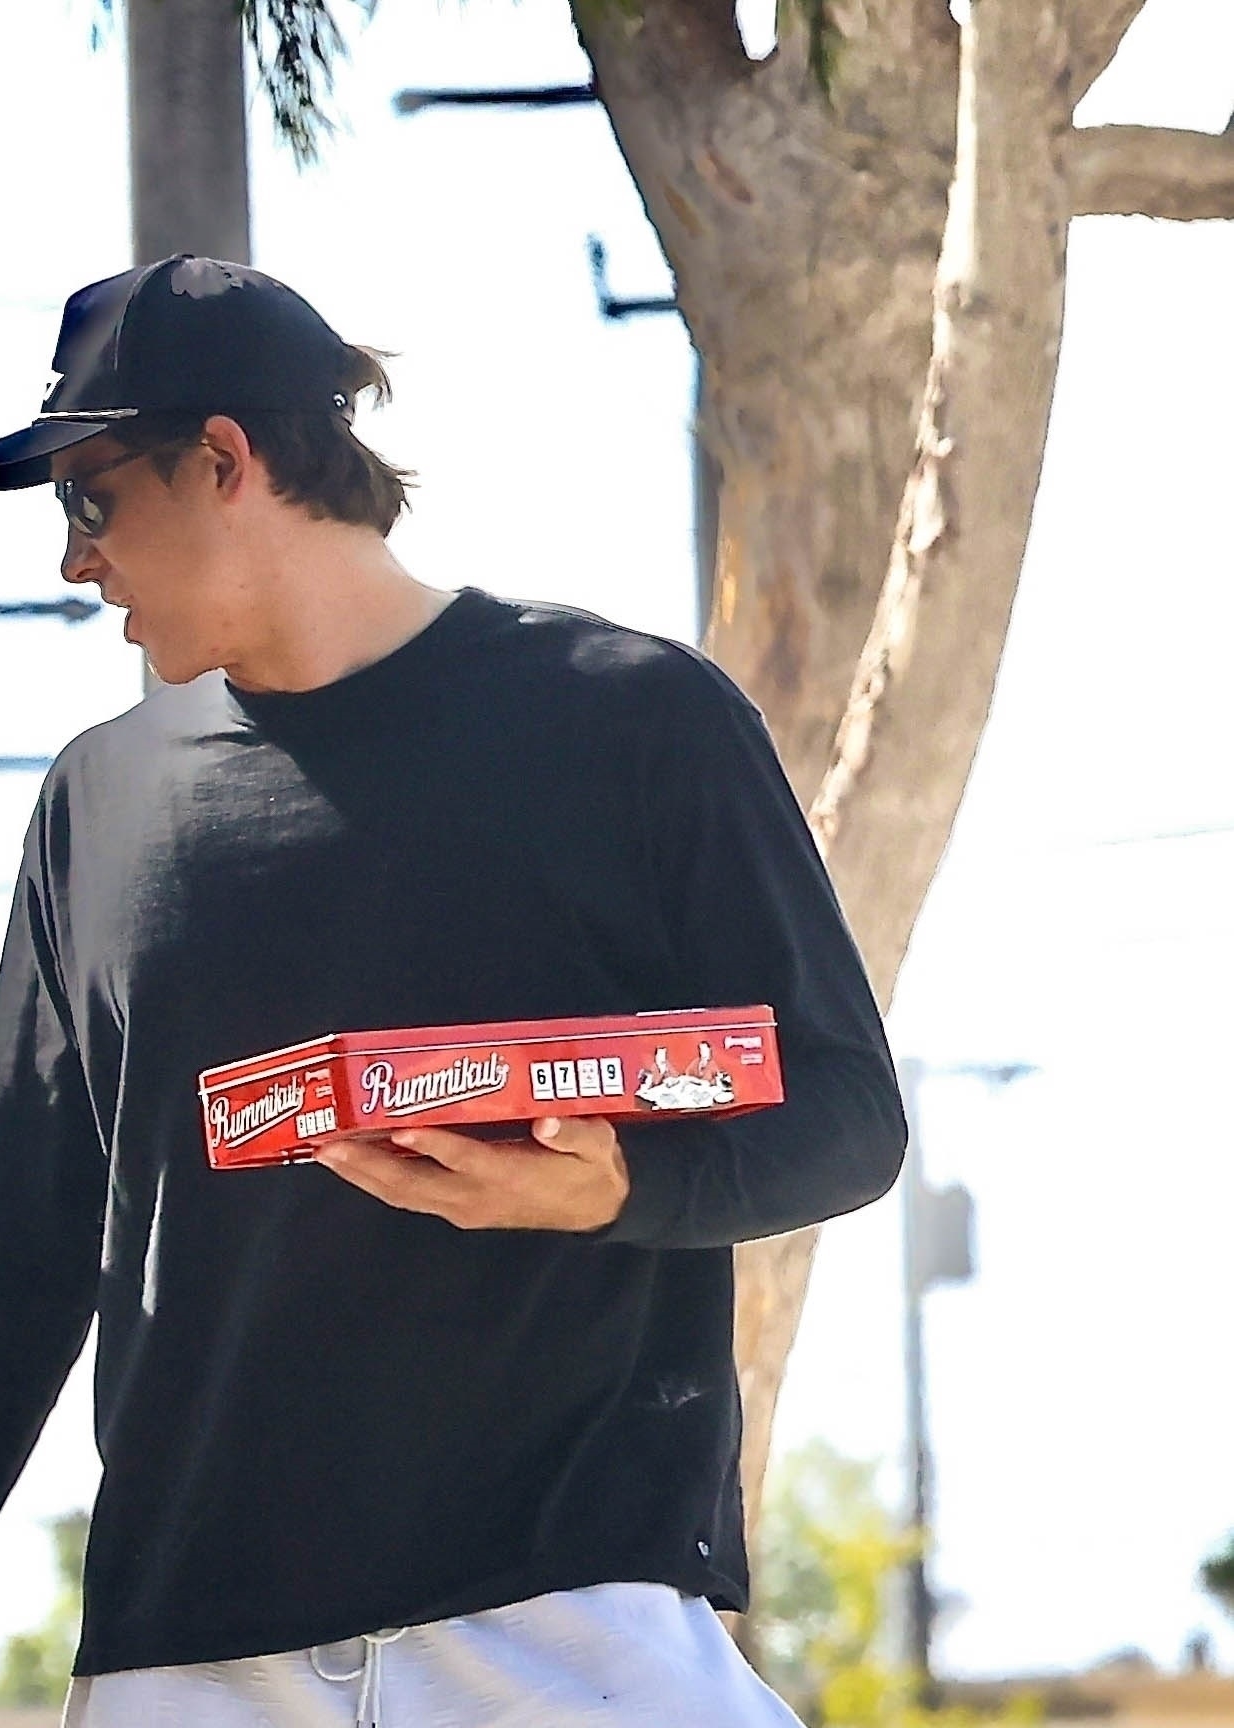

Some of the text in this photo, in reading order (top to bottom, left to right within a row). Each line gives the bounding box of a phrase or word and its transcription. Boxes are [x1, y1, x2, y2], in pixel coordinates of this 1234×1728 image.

[536, 1063, 616, 1085] 6 7 9
